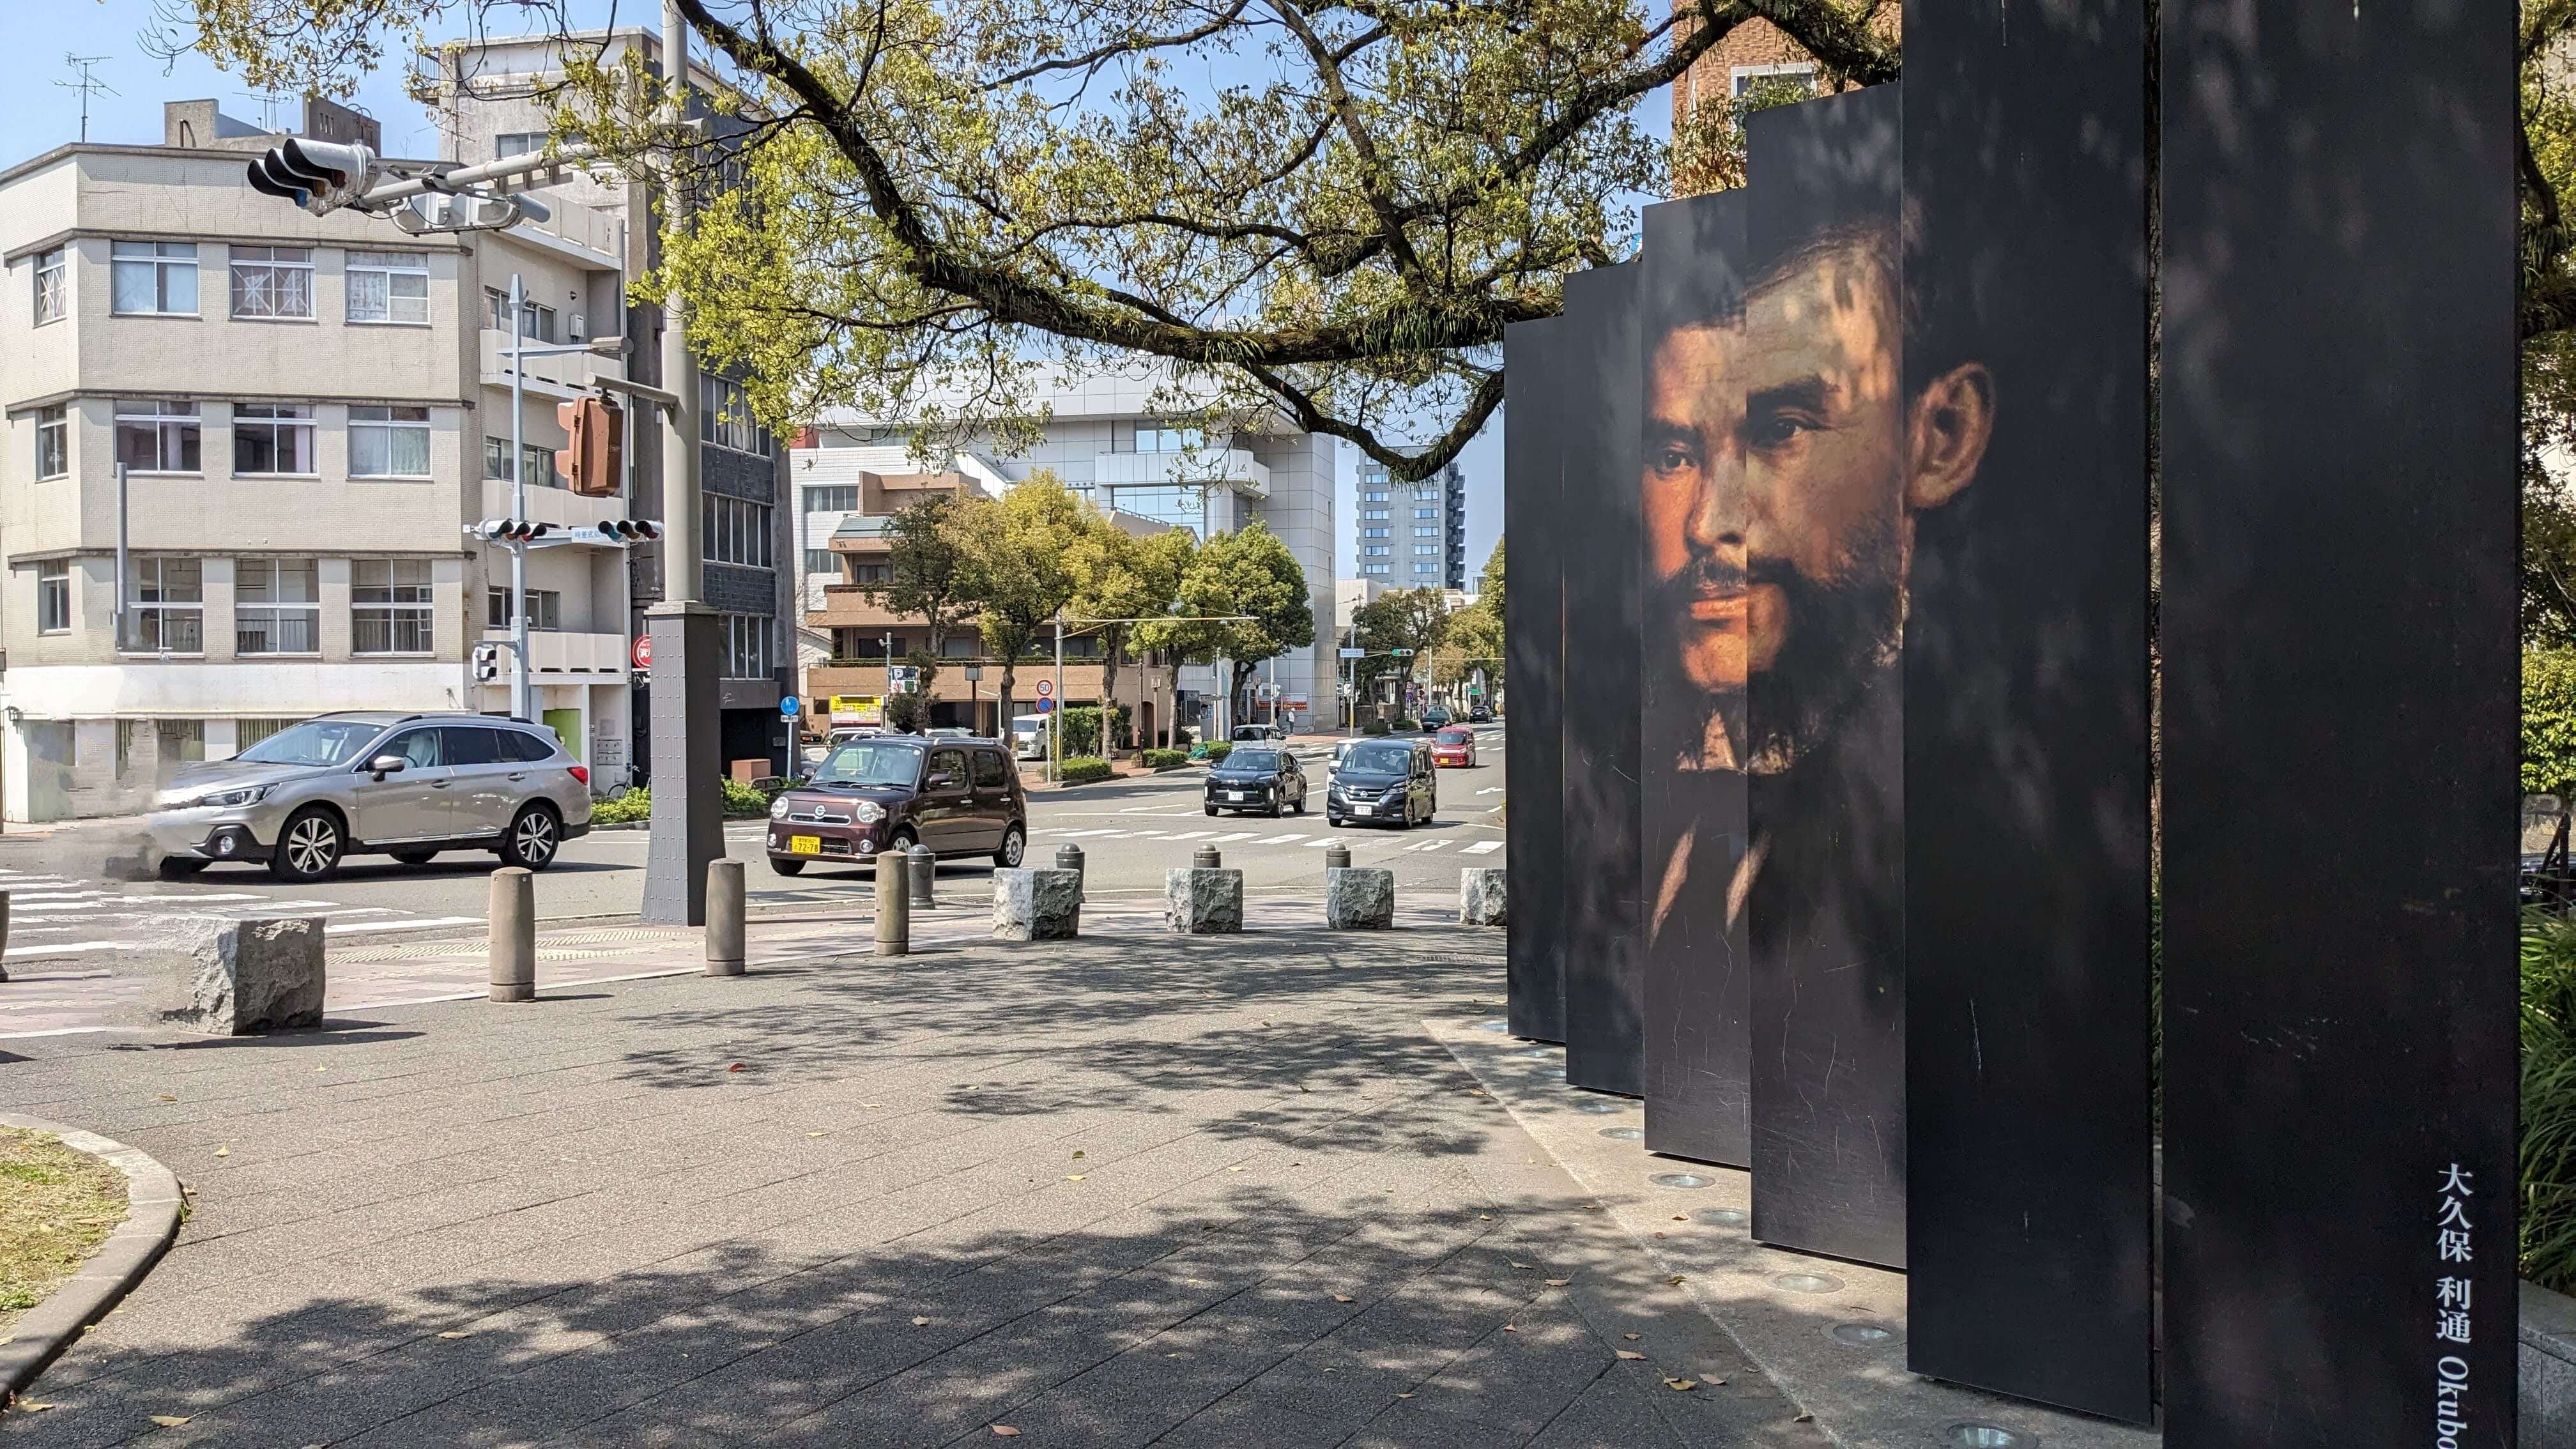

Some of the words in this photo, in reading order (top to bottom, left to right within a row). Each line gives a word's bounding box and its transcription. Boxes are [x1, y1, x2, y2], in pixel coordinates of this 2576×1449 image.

[894, 668, 903, 680] P
[799, 843, 818, 852] 72-78
[2436, 1163, 2474, 1262] 大久保
[2435, 1276, 2472, 1344] 利通
[2437, 1356, 2469, 1449] Okubo
